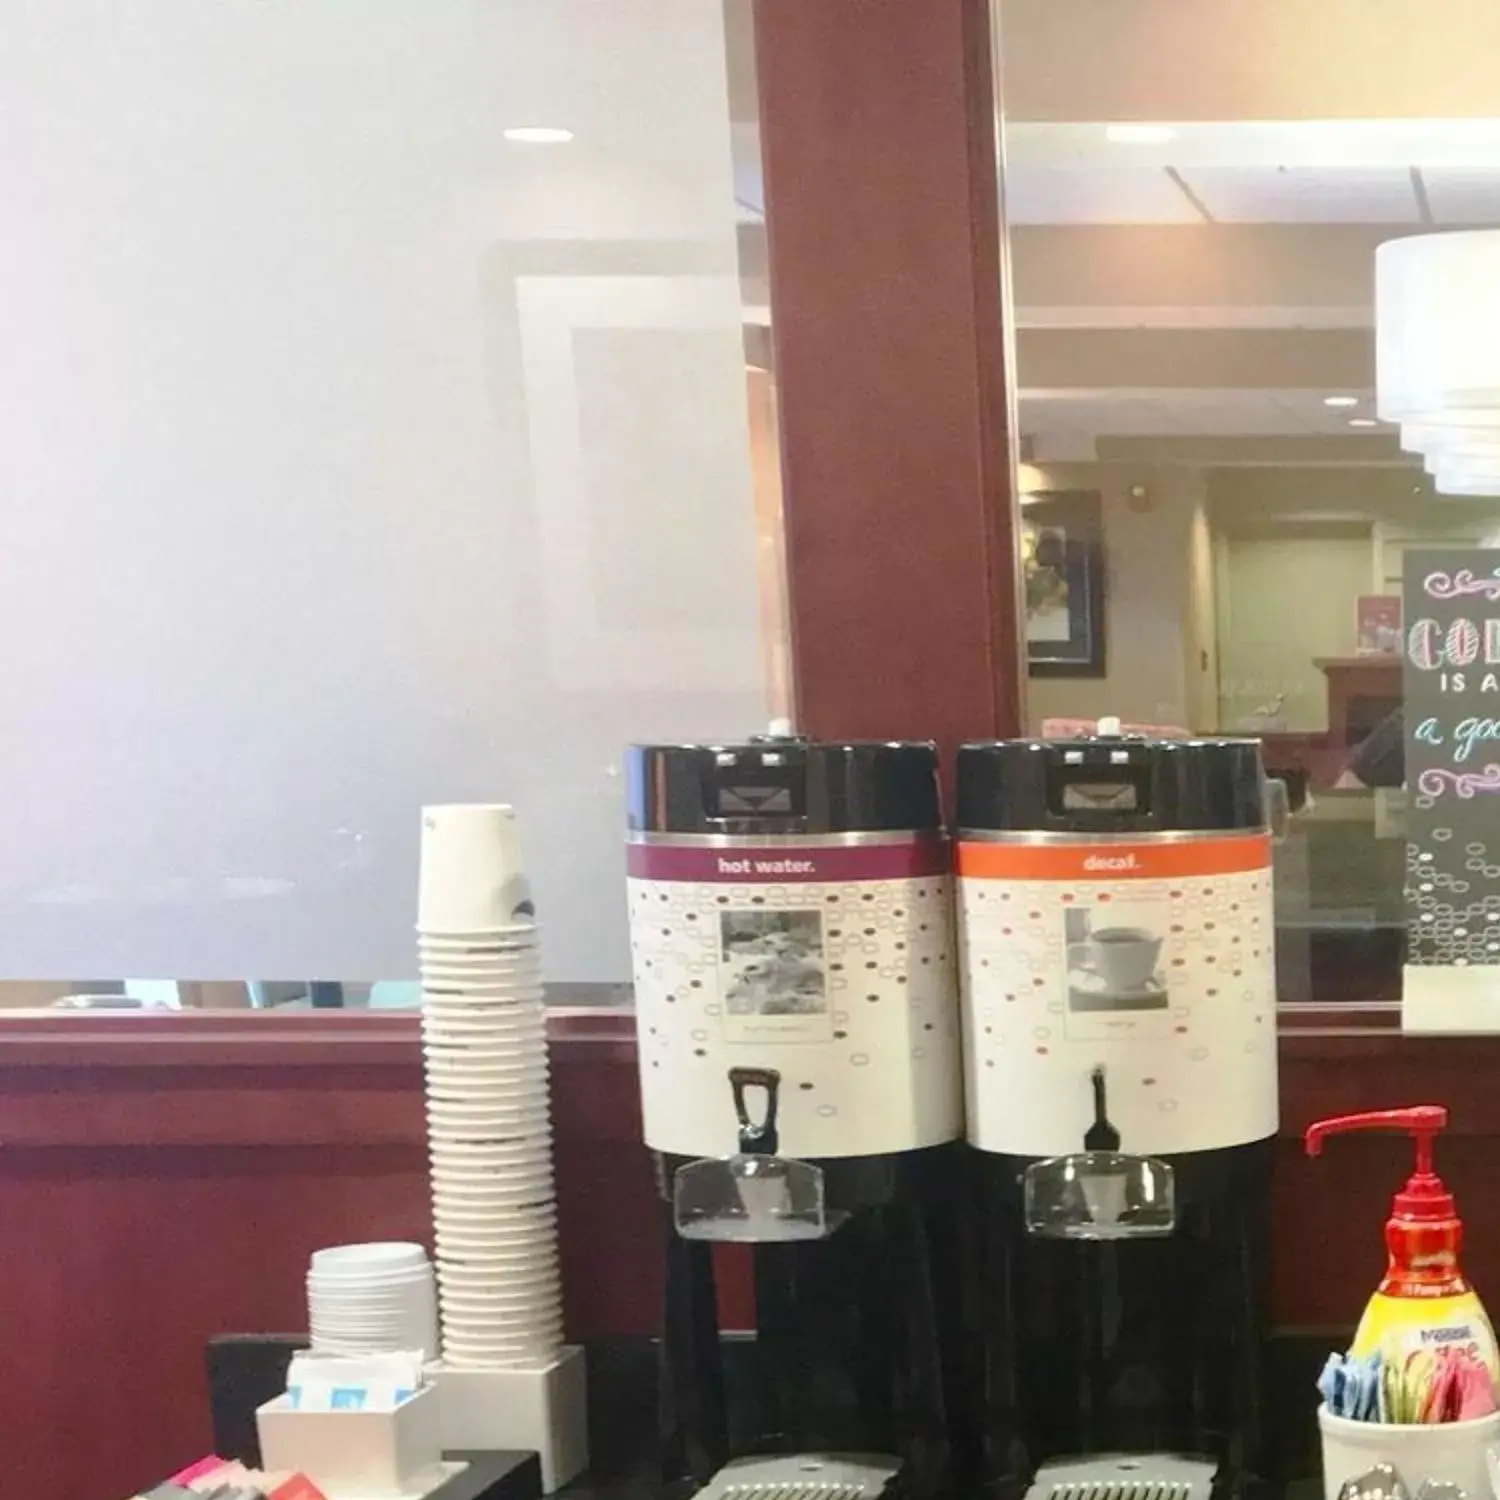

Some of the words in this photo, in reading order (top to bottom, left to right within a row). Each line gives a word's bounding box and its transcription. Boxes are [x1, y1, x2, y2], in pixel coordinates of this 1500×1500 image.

[1440, 672, 1466, 693] IS
[1414, 717, 1444, 745] a
[718, 857, 752, 873] hot
[755, 859, 816, 873] water.
